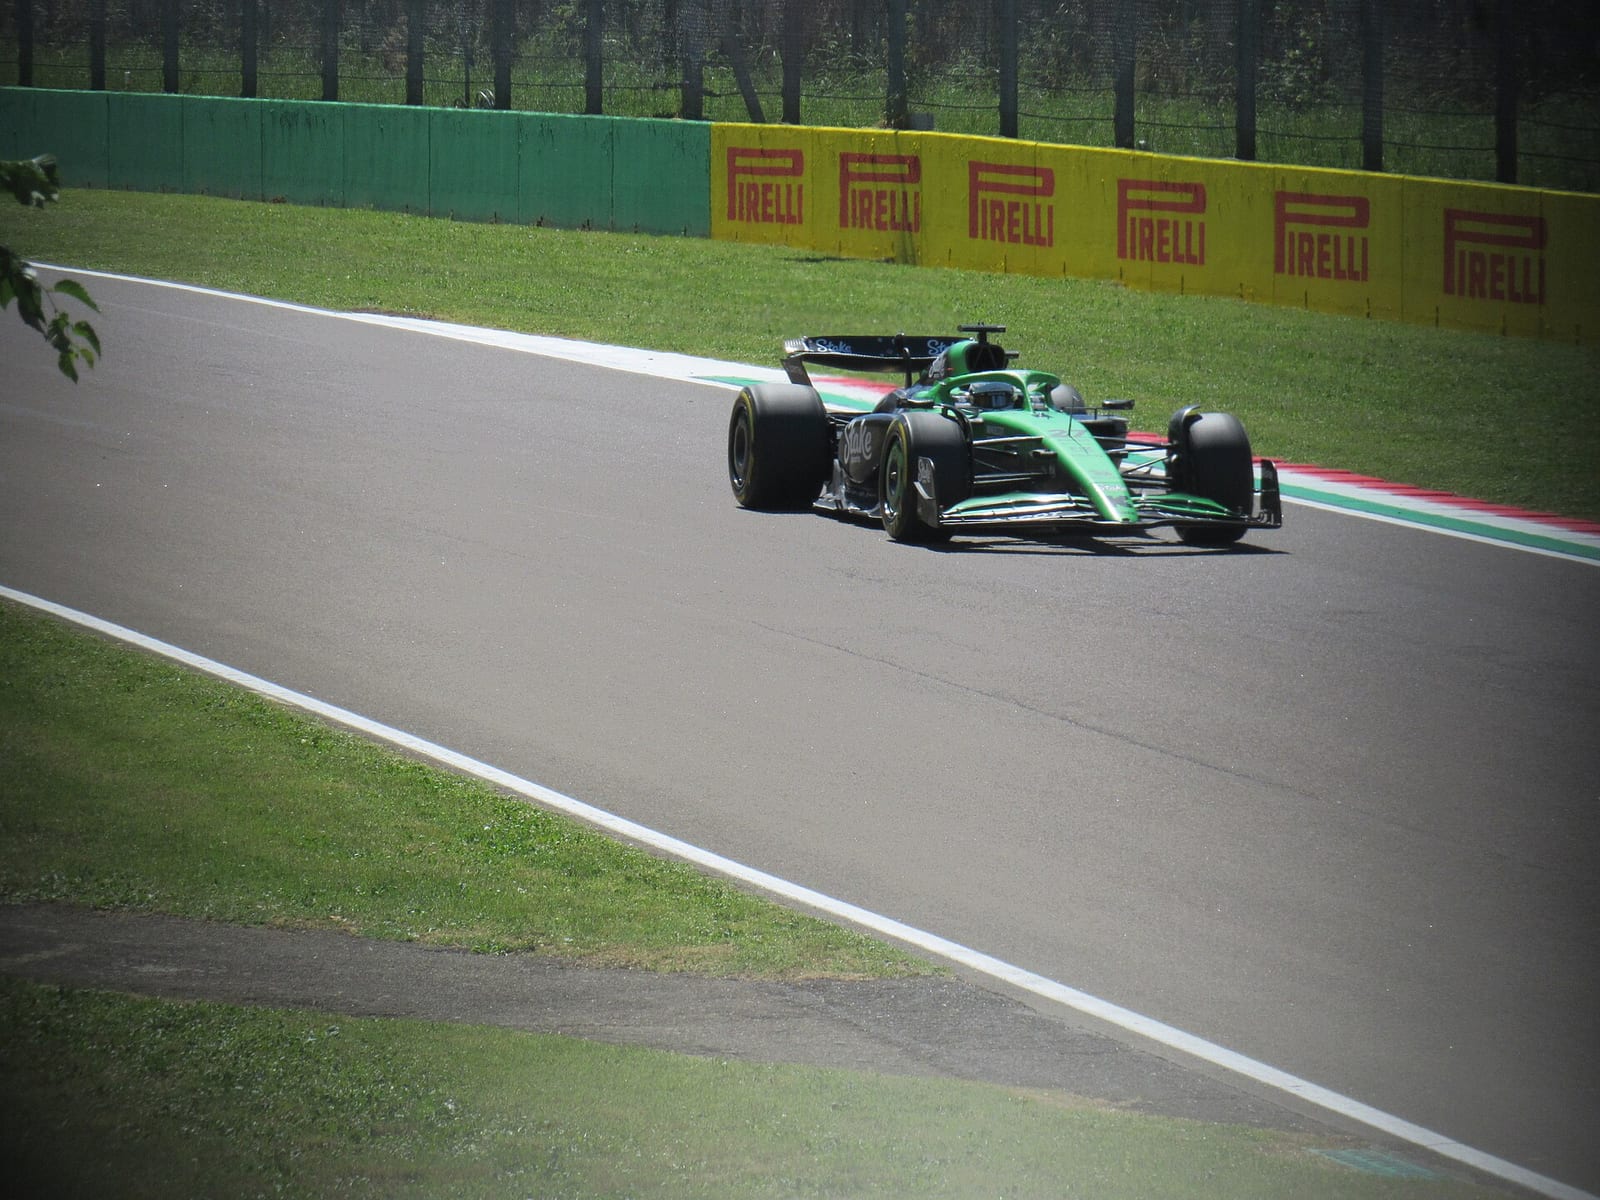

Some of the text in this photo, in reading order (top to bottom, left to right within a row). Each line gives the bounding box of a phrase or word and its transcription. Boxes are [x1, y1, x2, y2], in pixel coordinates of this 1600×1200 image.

[727, 146, 804, 225] PIRELLI
[839, 152, 921, 233] PIRELLI
[968, 160, 1055, 248] PIRELLI
[1117, 178, 1207, 266] PIRELLI
[1274, 190, 1371, 282] PIRELLI
[1443, 208, 1547, 304] PIRELLI
[815, 338, 852, 353] Stake
[843, 418, 873, 465] Stake
